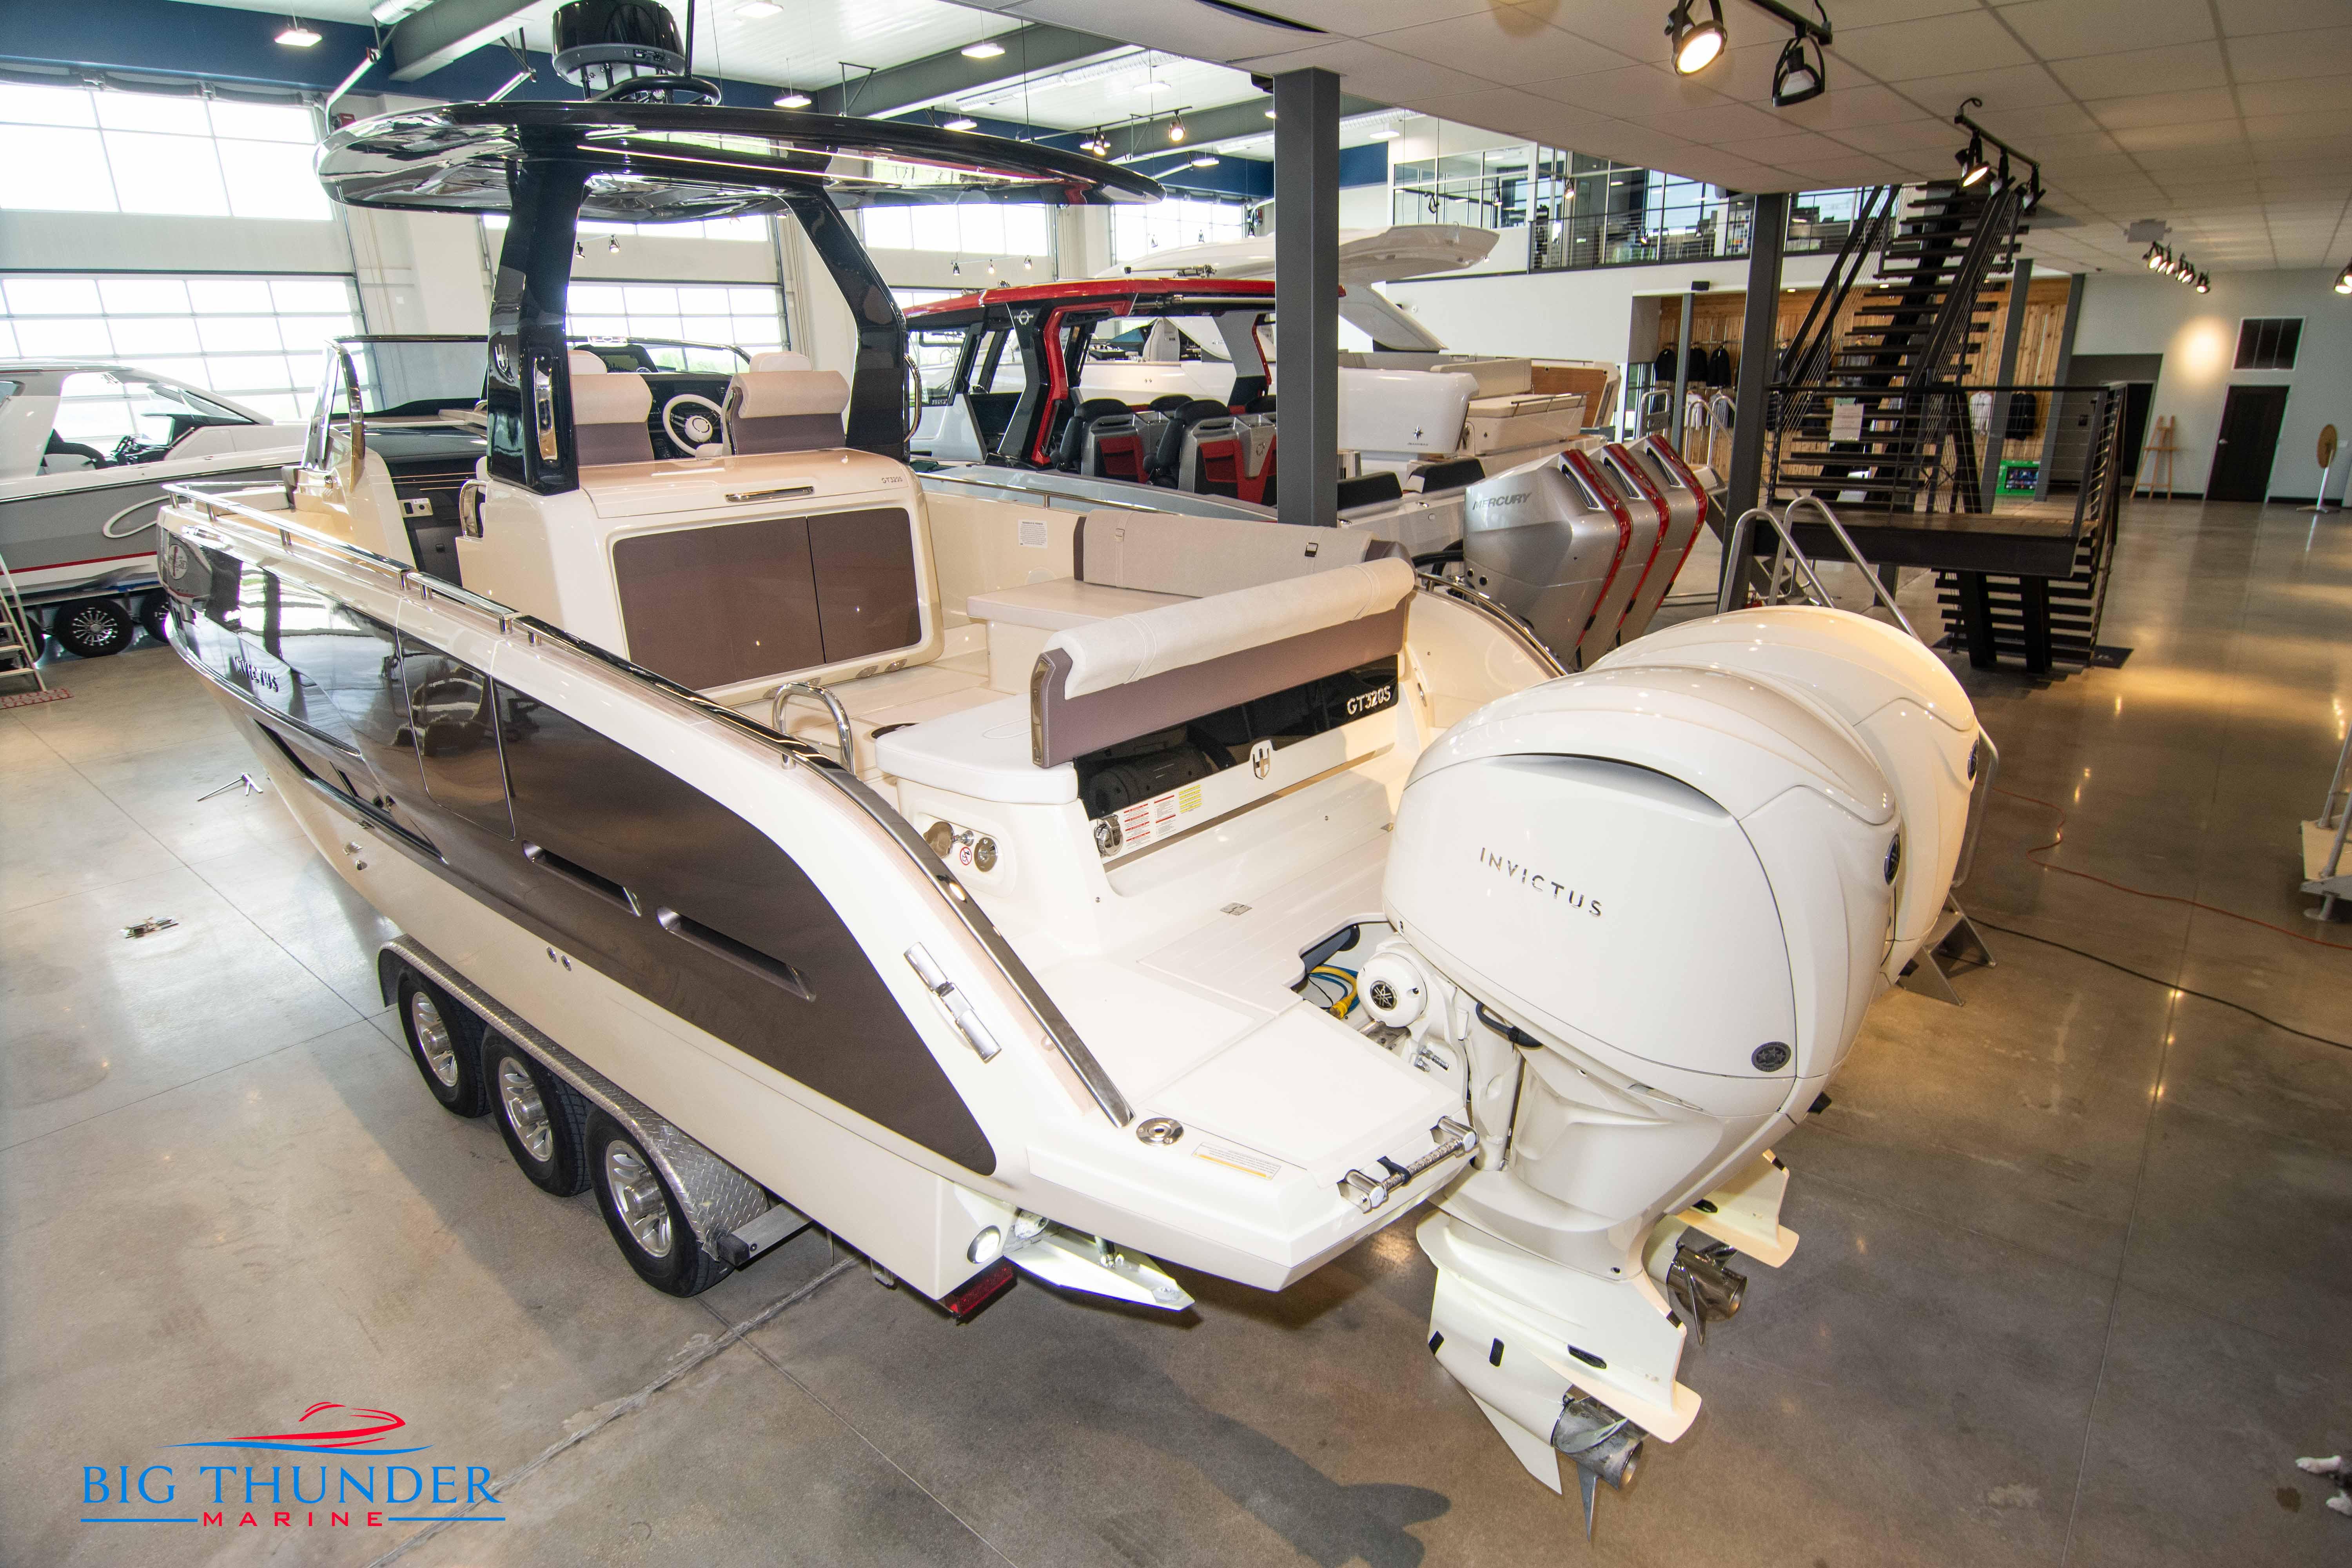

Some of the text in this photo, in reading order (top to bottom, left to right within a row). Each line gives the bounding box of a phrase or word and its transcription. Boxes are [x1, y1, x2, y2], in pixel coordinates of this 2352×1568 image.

[1472, 492, 1532, 510] MERCURY
[1347, 685, 1391, 715] GT320S
[1480, 847, 1602, 917] INVICTUS
